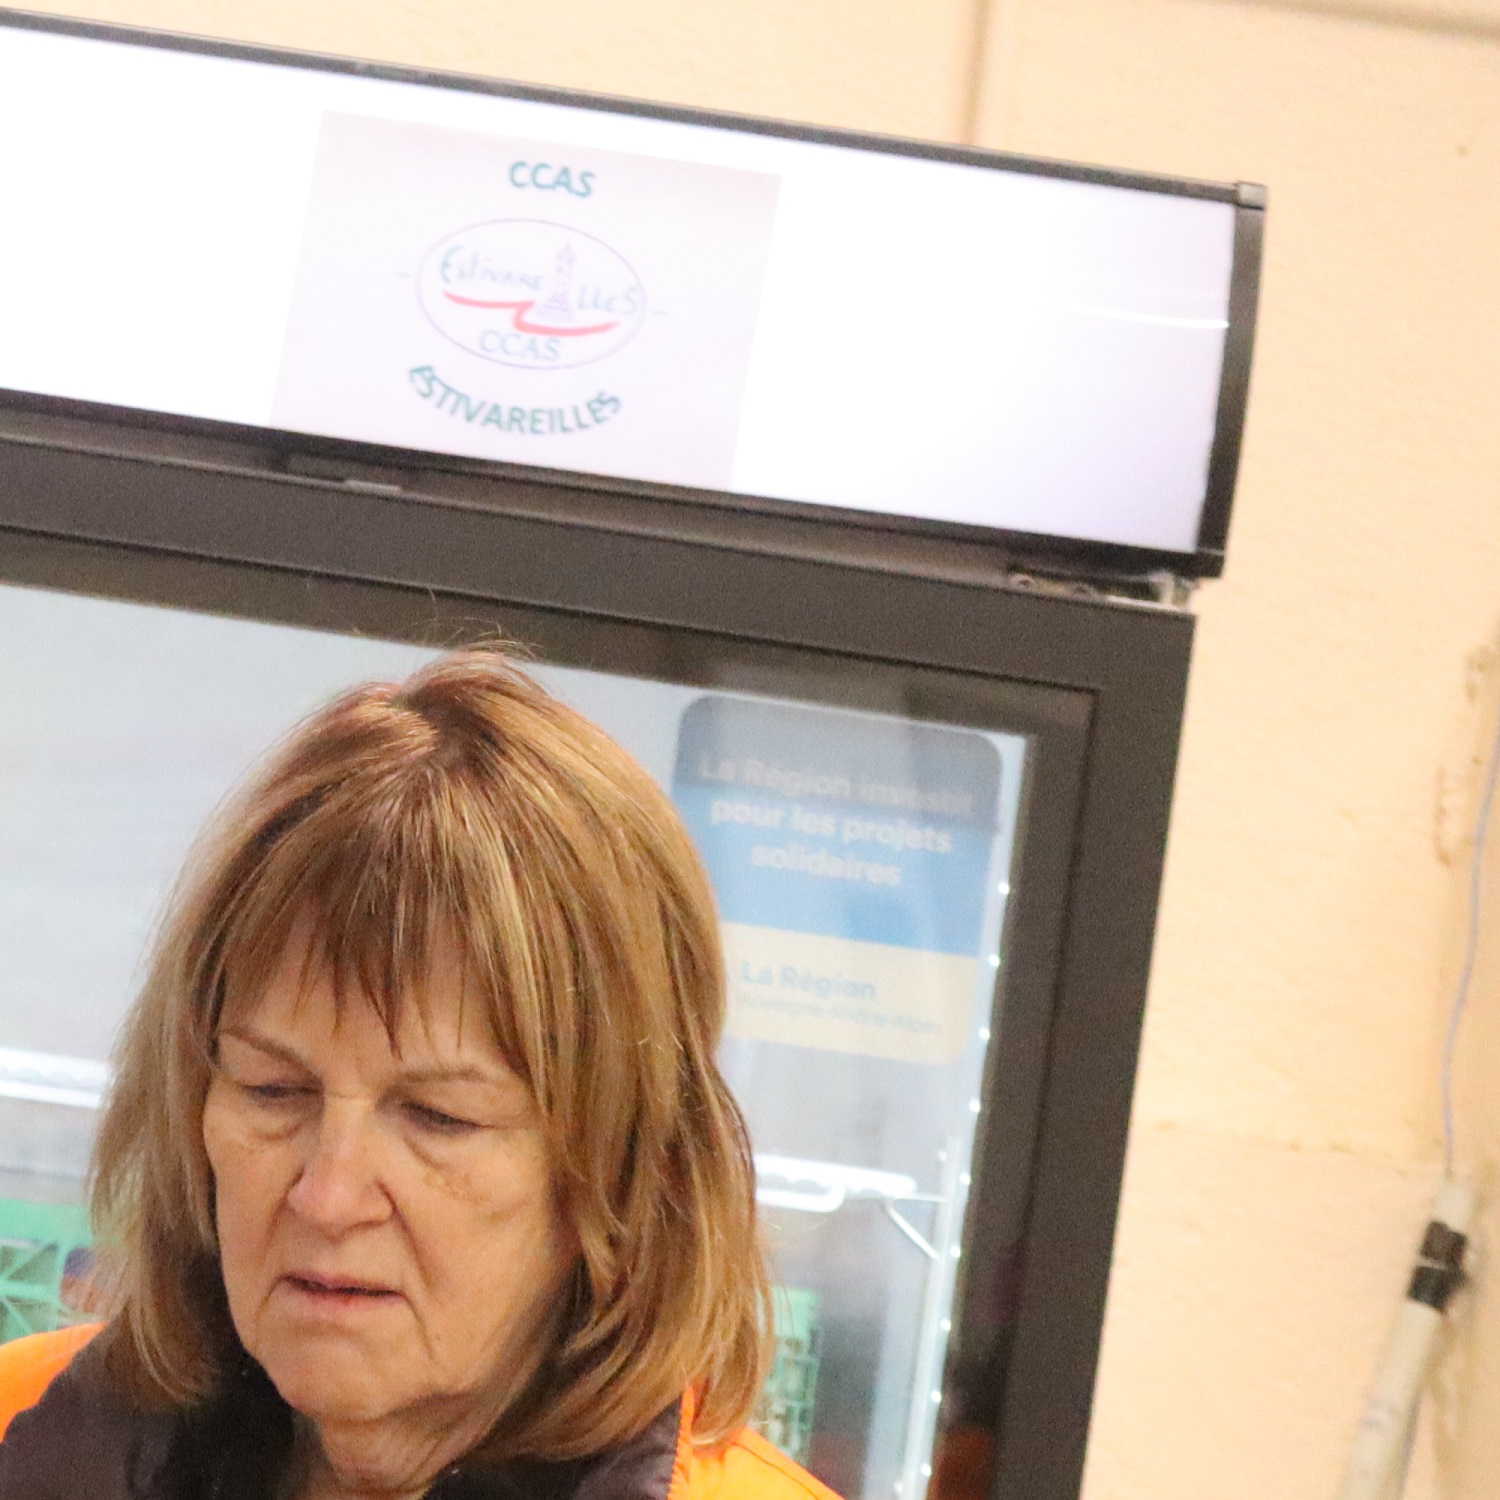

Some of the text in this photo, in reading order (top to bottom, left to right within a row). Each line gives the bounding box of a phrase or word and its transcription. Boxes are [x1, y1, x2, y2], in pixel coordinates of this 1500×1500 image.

[508, 160, 597, 198] CCAS
[478, 329, 562, 362] CCAS
[409, 364, 622, 435] ESTIVAREILLES
[709, 797, 952, 854] pour les projets
[751, 844, 902, 888] solidaires
[741, 960, 877, 1002] La Région
